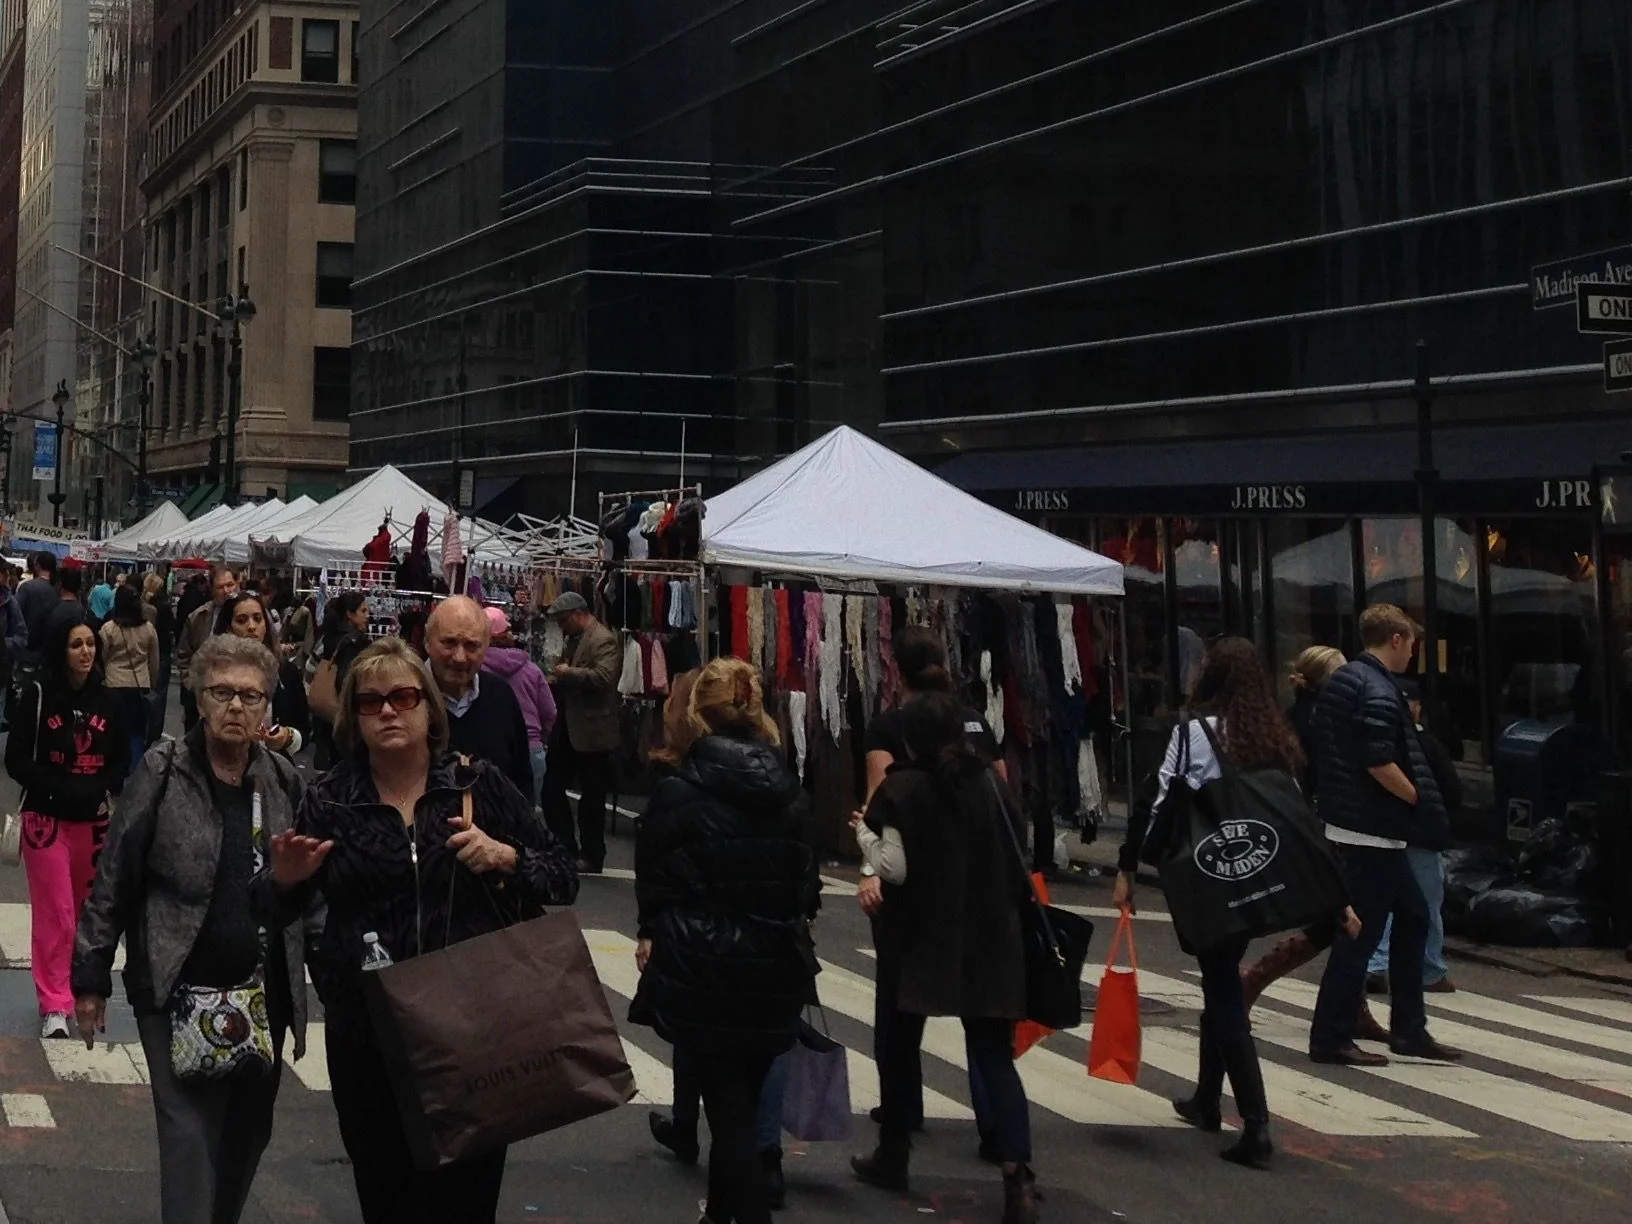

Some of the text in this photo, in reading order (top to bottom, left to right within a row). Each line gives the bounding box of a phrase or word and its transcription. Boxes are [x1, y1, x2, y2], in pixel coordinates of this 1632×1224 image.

[1015, 490, 1069, 510] J.PRESS
[1231, 486, 1306, 509] J.PRESS
[17, 523, 36, 534] THAI
[39, 528, 63, 539] FOOD
[465, 1065, 516, 1095] LOUIS
